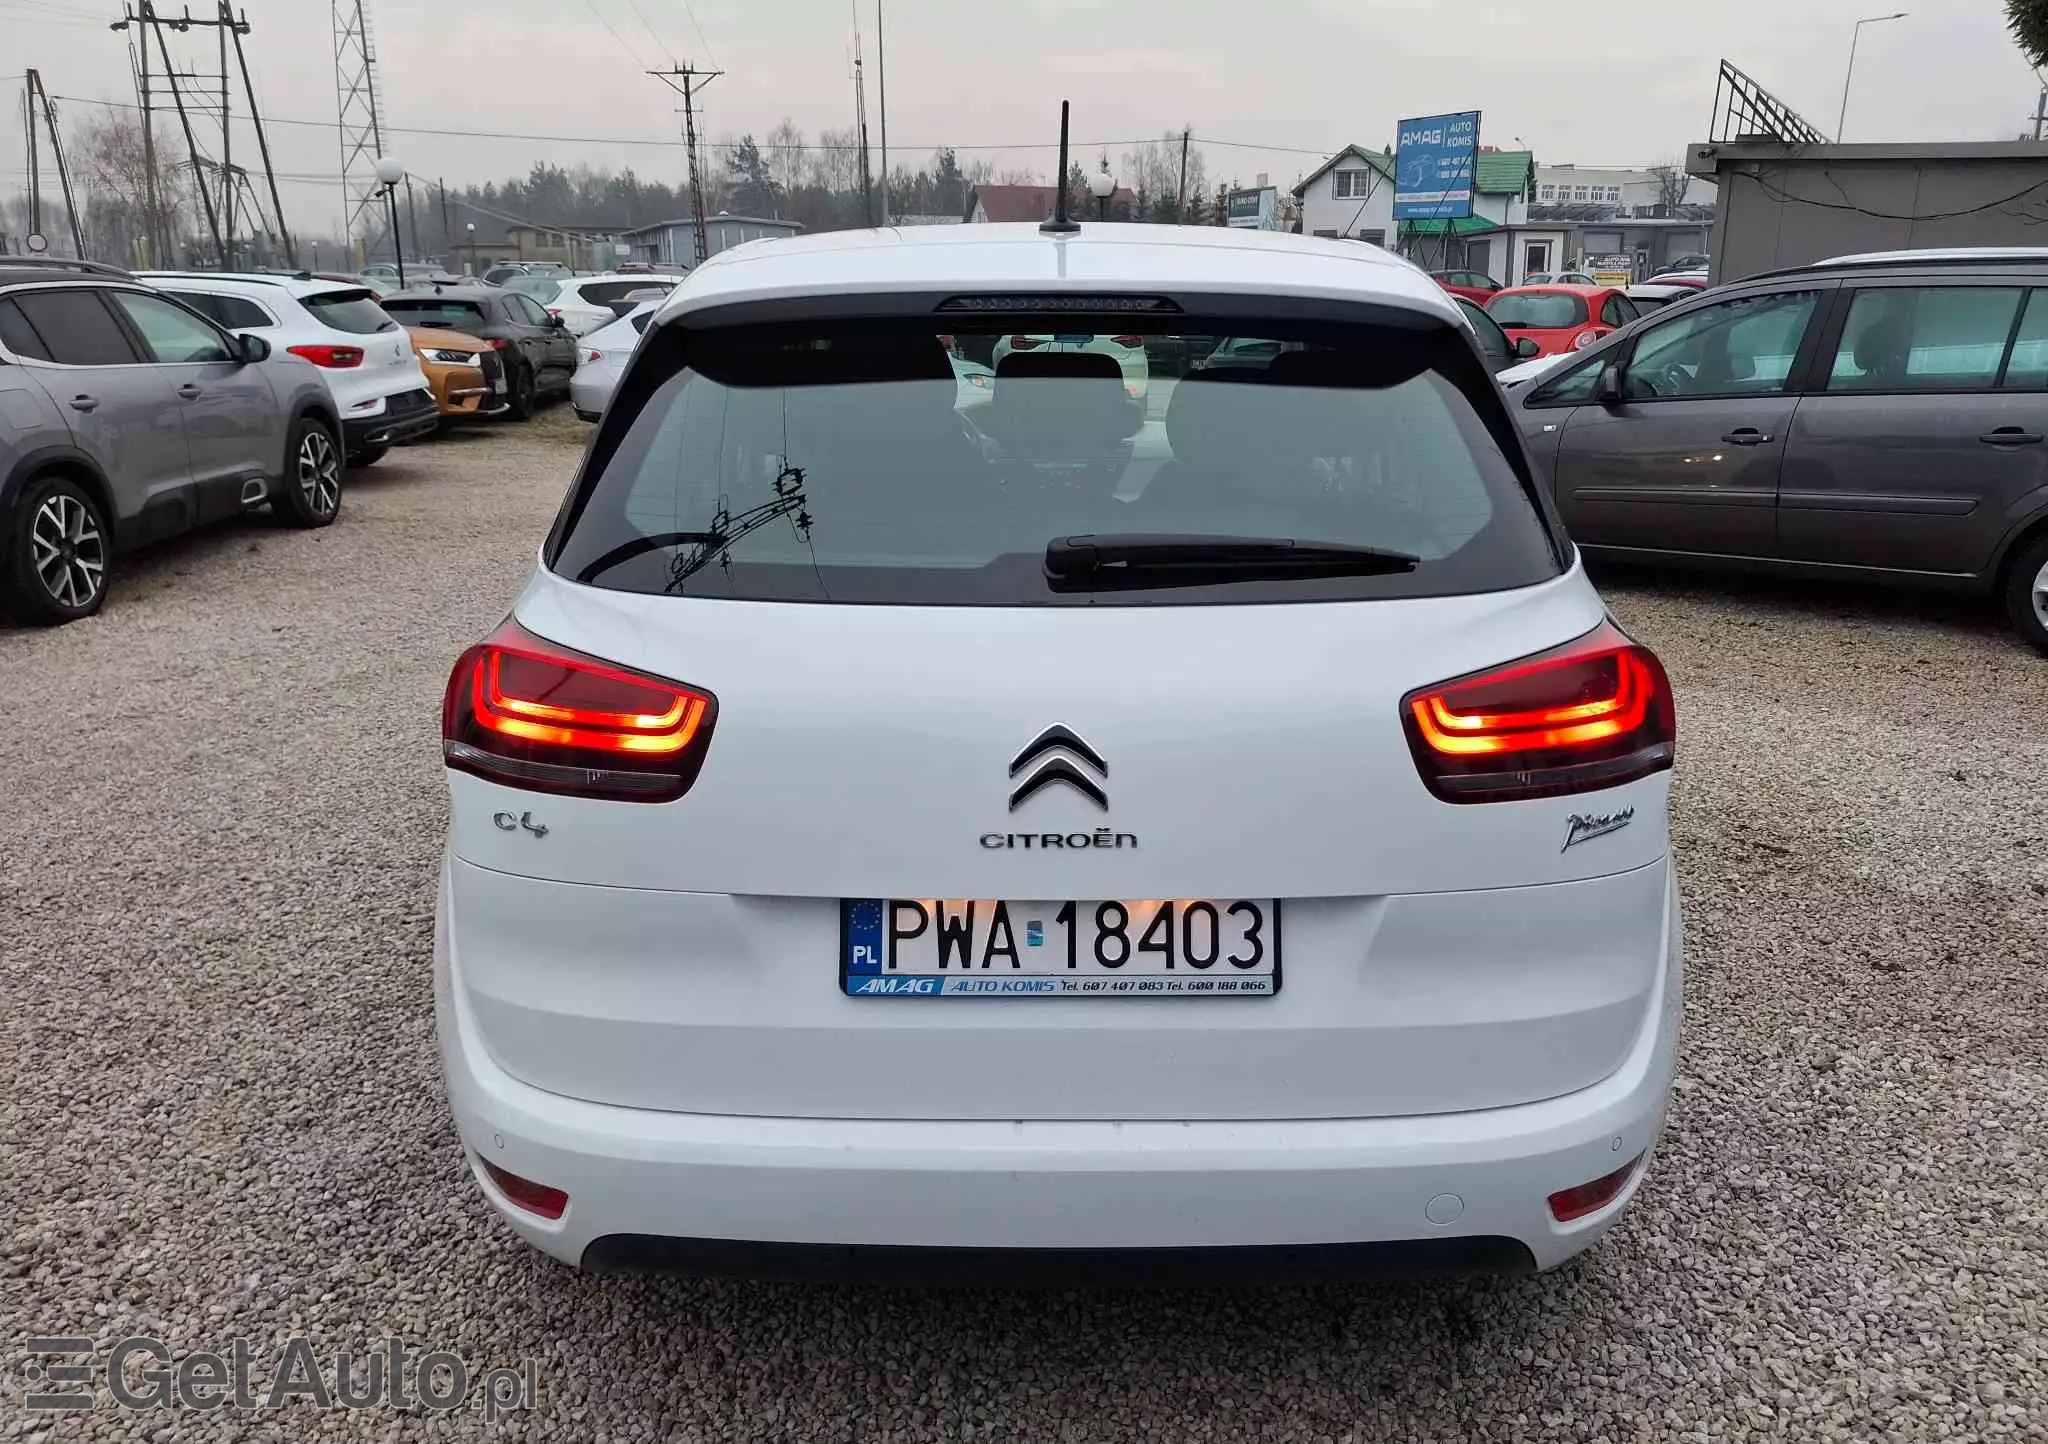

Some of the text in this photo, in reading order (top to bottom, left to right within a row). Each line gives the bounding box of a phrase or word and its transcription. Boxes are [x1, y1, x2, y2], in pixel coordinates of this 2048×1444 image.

[1449, 121, 1472, 134] AUTO
[1400, 129, 1441, 147] AMAG
[1447, 135, 1472, 147] KOMIS
[494, 811, 549, 839] C4
[888, 900, 1264, 969] PWA 18403
[853, 945, 877, 964] PL
[856, 978, 1266, 993] AMAG AUTO KOMIS Tel. 607 407 083 Tel. 600 188 066
